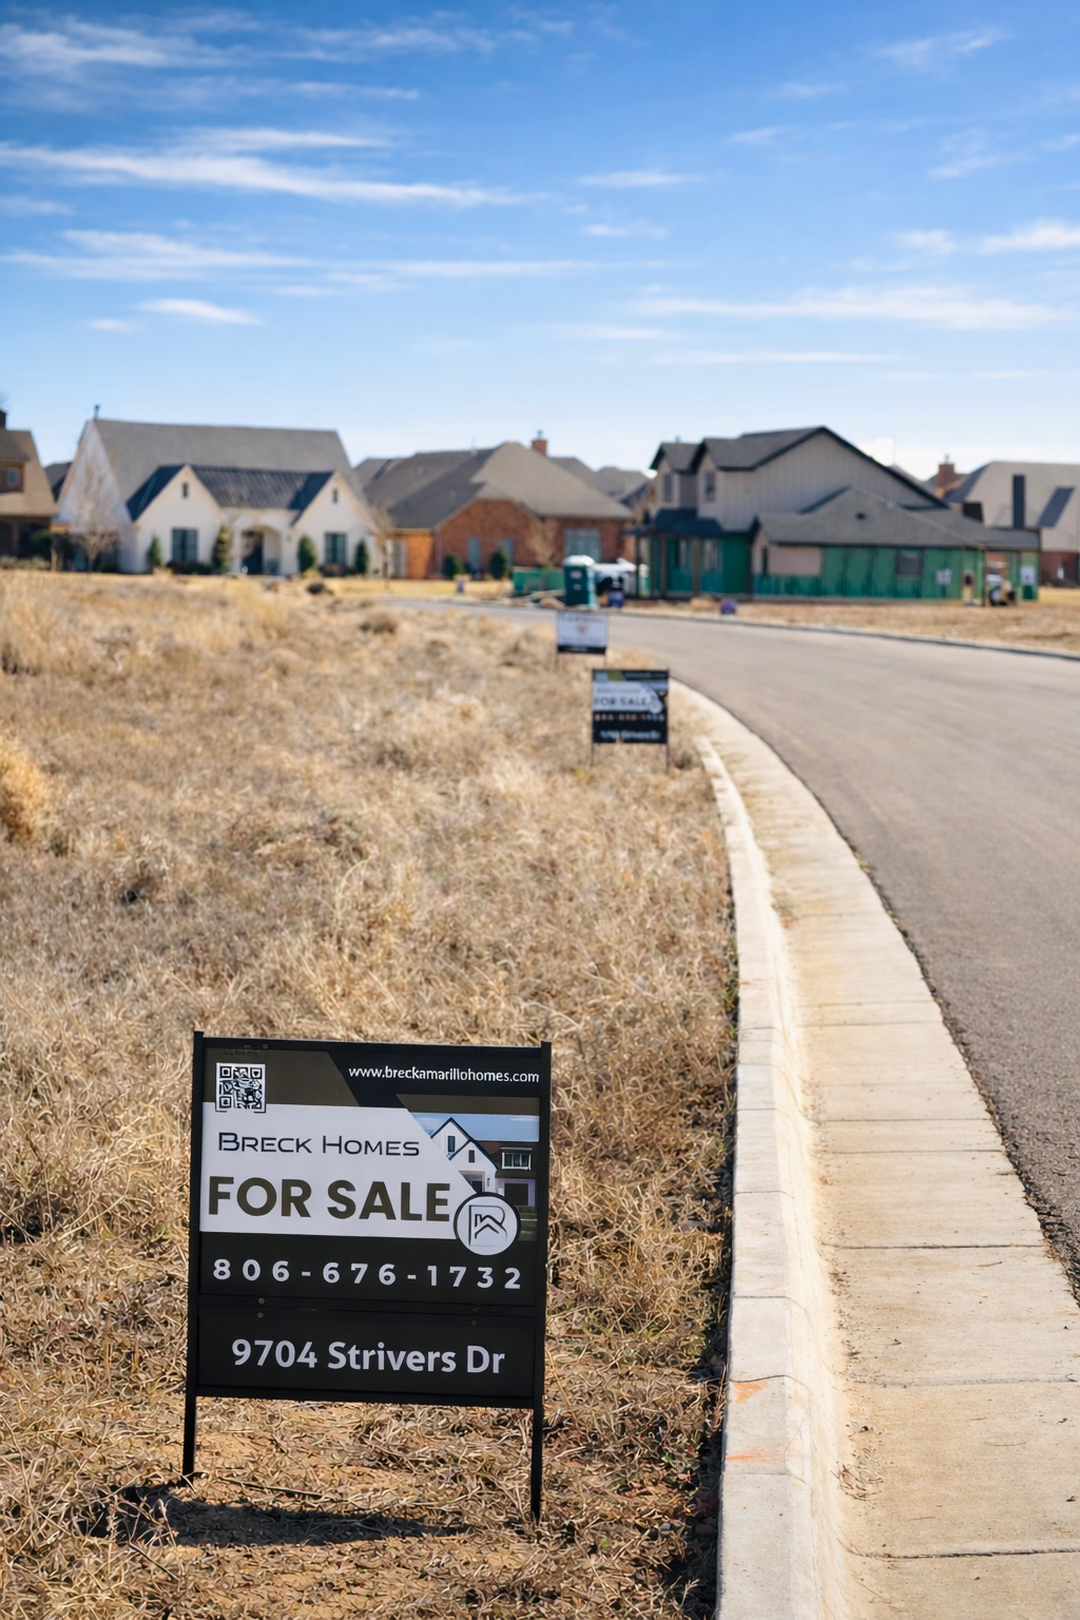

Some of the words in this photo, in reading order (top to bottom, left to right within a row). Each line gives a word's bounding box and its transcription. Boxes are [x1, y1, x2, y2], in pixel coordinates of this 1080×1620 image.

[348, 1065, 540, 1083] www.breckamarillohomes.com
[218, 1132, 313, 1154] BRECK
[322, 1135, 420, 1156] HOMES
[208, 1176, 312, 1218] FOR
[326, 1179, 451, 1222] SALE
[213, 1258, 522, 1290] 806-676-1732
[231, 1338, 318, 1368] 9704
[327, 1341, 457, 1372] Strivers
[467, 1345, 506, 1374] Dr
